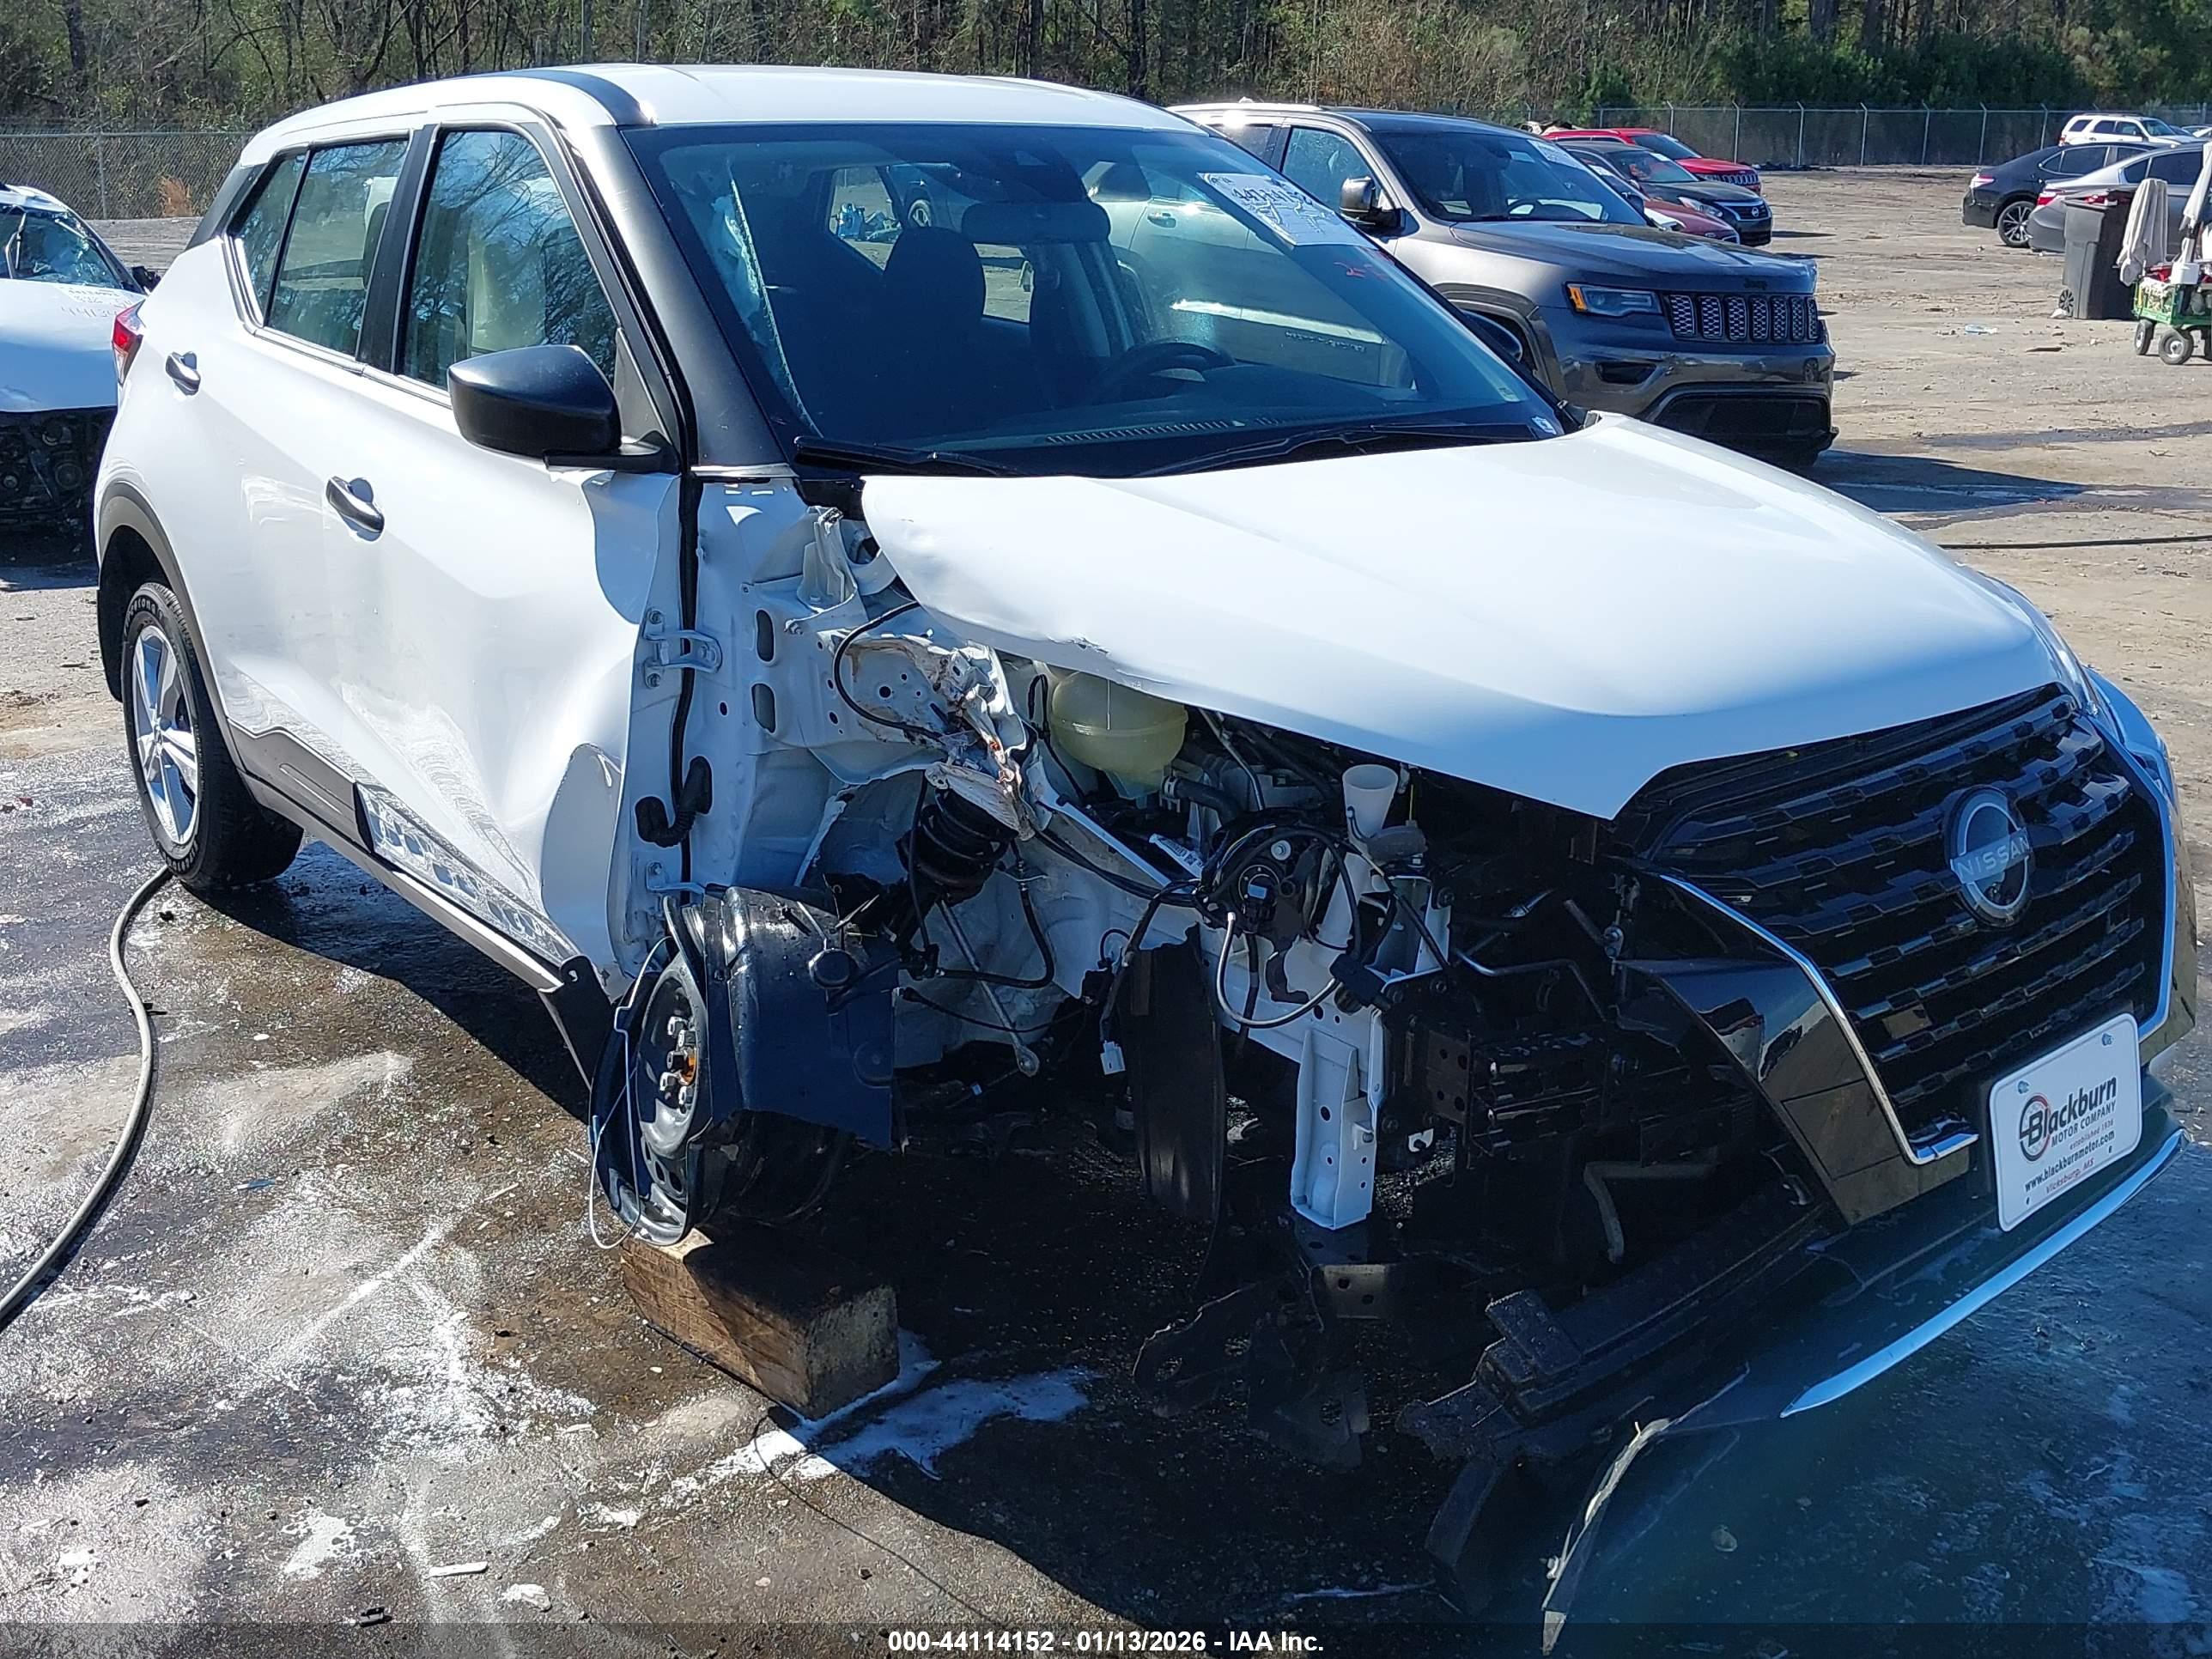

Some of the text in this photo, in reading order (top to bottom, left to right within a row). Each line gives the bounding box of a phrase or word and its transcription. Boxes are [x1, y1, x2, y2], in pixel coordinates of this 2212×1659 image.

[1957, 836, 2030, 876] NISSAN
[2021, 1077, 2117, 1148] Blackburn
[2051, 1101, 2116, 1147] MOTOR COMPANY
[2069, 1127, 2100, 1150] established
[2025, 1131, 2114, 1192] www.blackburnmotor.com
[2083, 1158, 2094, 1170] MS
